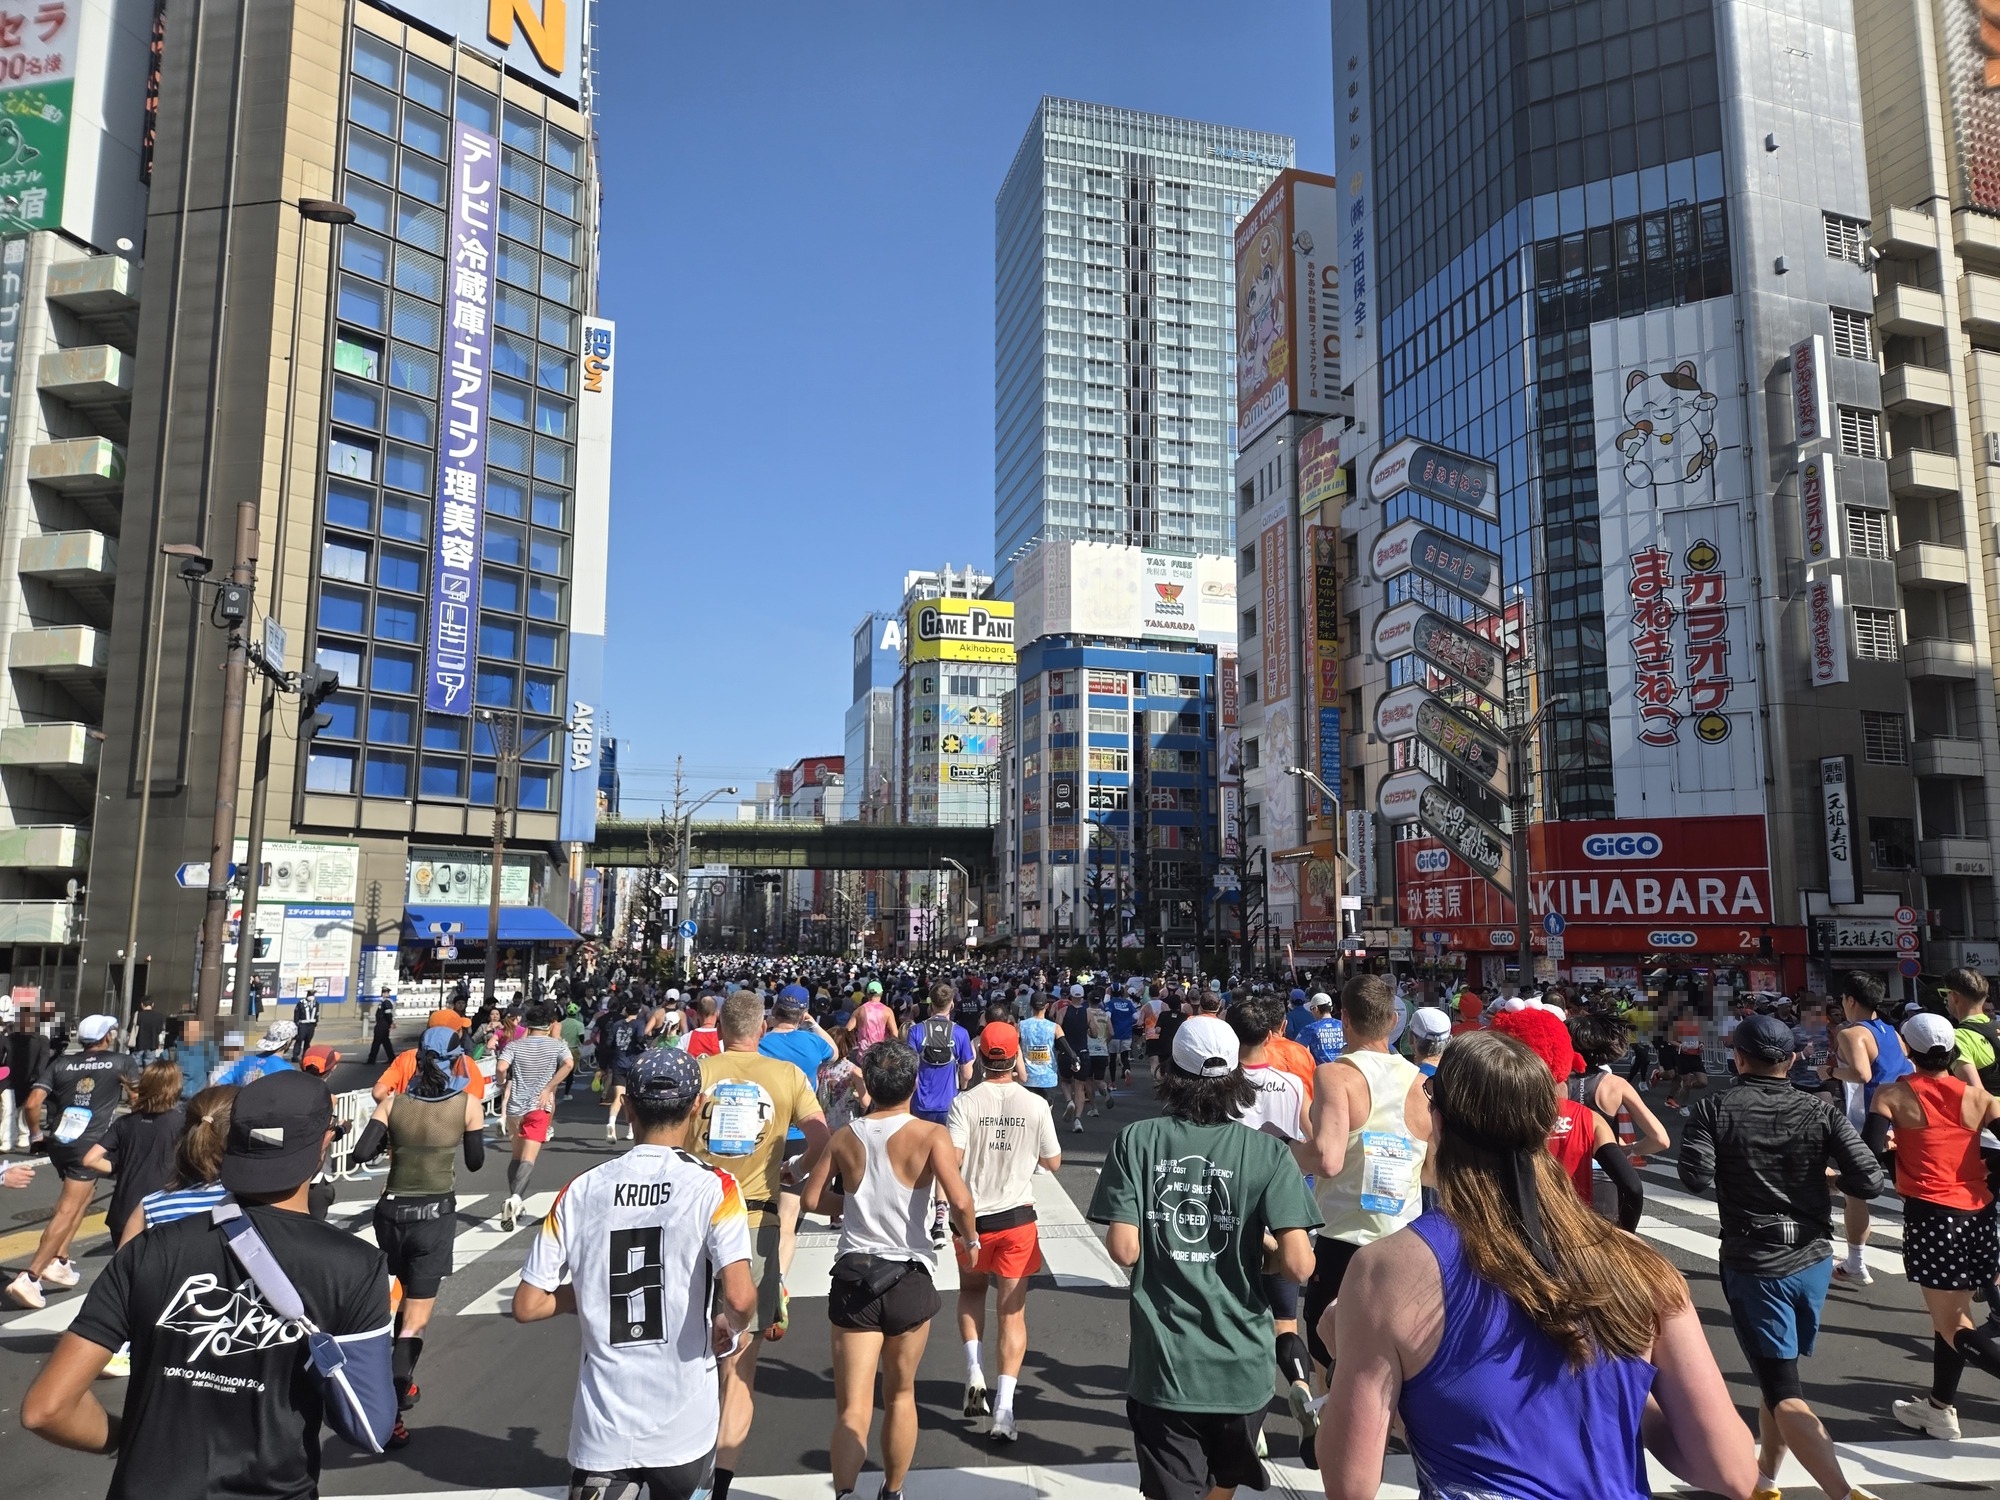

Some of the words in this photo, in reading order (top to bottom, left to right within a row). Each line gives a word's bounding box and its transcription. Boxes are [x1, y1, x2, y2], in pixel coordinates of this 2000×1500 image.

[1235, 219, 1258, 254] FIGURE
[1259, 185, 1285, 228] TOWER
[1350, 196, 1367, 326] (株)半田保全
[1307, 262, 1318, 398] あみあみ秋葉原フィギュアタワー店
[441, 132, 491, 571] テレビ・冷蔵庫・エアコン・理美容
[584, 327, 611, 393] EDION
[1794, 343, 1817, 438] まねきねこ
[1242, 376, 1285, 430] amiami
[1423, 459, 1482, 498] まねきねこ
[1262, 504, 1286, 527] amiami
[1804, 475, 1824, 544] カラオケ
[1058, 543, 1067, 599] WELCOME
[1146, 557, 1166, 567] TAX
[1170, 560, 1193, 570] FREE
[1317, 567, 1335, 576] ゲーム
[1424, 544, 1475, 580] カラオケ
[1317, 588, 1336, 597] アイドル
[1319, 578, 1334, 586] CD
[1058, 601, 1067, 617] TO
[1317, 599, 1336, 608] アニメ
[921, 609, 967, 636] GAME
[1319, 620, 1335, 628] ホビー
[1811, 582, 1835, 681] まねきねこ
[959, 643, 1006, 654] Akihabara
[1628, 544, 1683, 747] まねきねこ
[1681, 571, 1734, 716] カラオケ
[1224, 668, 1235, 716] FIGURE
[1321, 659, 1338, 702] DVD
[571, 700, 594, 772] AKIBA
[1431, 716, 1482, 761] カラオケ
[1056, 801, 1070, 810] PSA
[1827, 792, 1848, 862] 元祖寿司
[1587, 836, 1660, 856] GiGO
[1417, 851, 1448, 869] GiGO
[1407, 884, 1463, 920] 秋葉原
[1899, 912, 1911, 921] 40
[1491, 932, 1514, 944] GiGO
[1650, 933, 1696, 944] GiGO
[1838, 929, 1893, 947] 元祖寿司
[65, 1061, 113, 1071] ALFREDO
[979, 1114, 1026, 1128] HERNÁNDEZ
[995, 1129, 1006, 1139] DE
[988, 1141, 1012, 1151] MARIA
[1172, 1166, 1187, 1175] COST
[613, 1182, 672, 1206] KROOS
[1173, 1181, 1190, 1192] NEW
[1191, 1184, 1212, 1195] SHOES
[1179, 1214, 1206, 1226] SPEED
[1219, 1223, 1234, 1232] HIGH
[1169, 1249, 1190, 1261] MORE
[1190, 1252, 1210, 1262] RUNS
[610, 1226, 668, 1348] 8
[163, 1366, 194, 1379] TOKYO
[195, 1370, 246, 1387] MARATHON
[247, 1379, 266, 1392] 206
